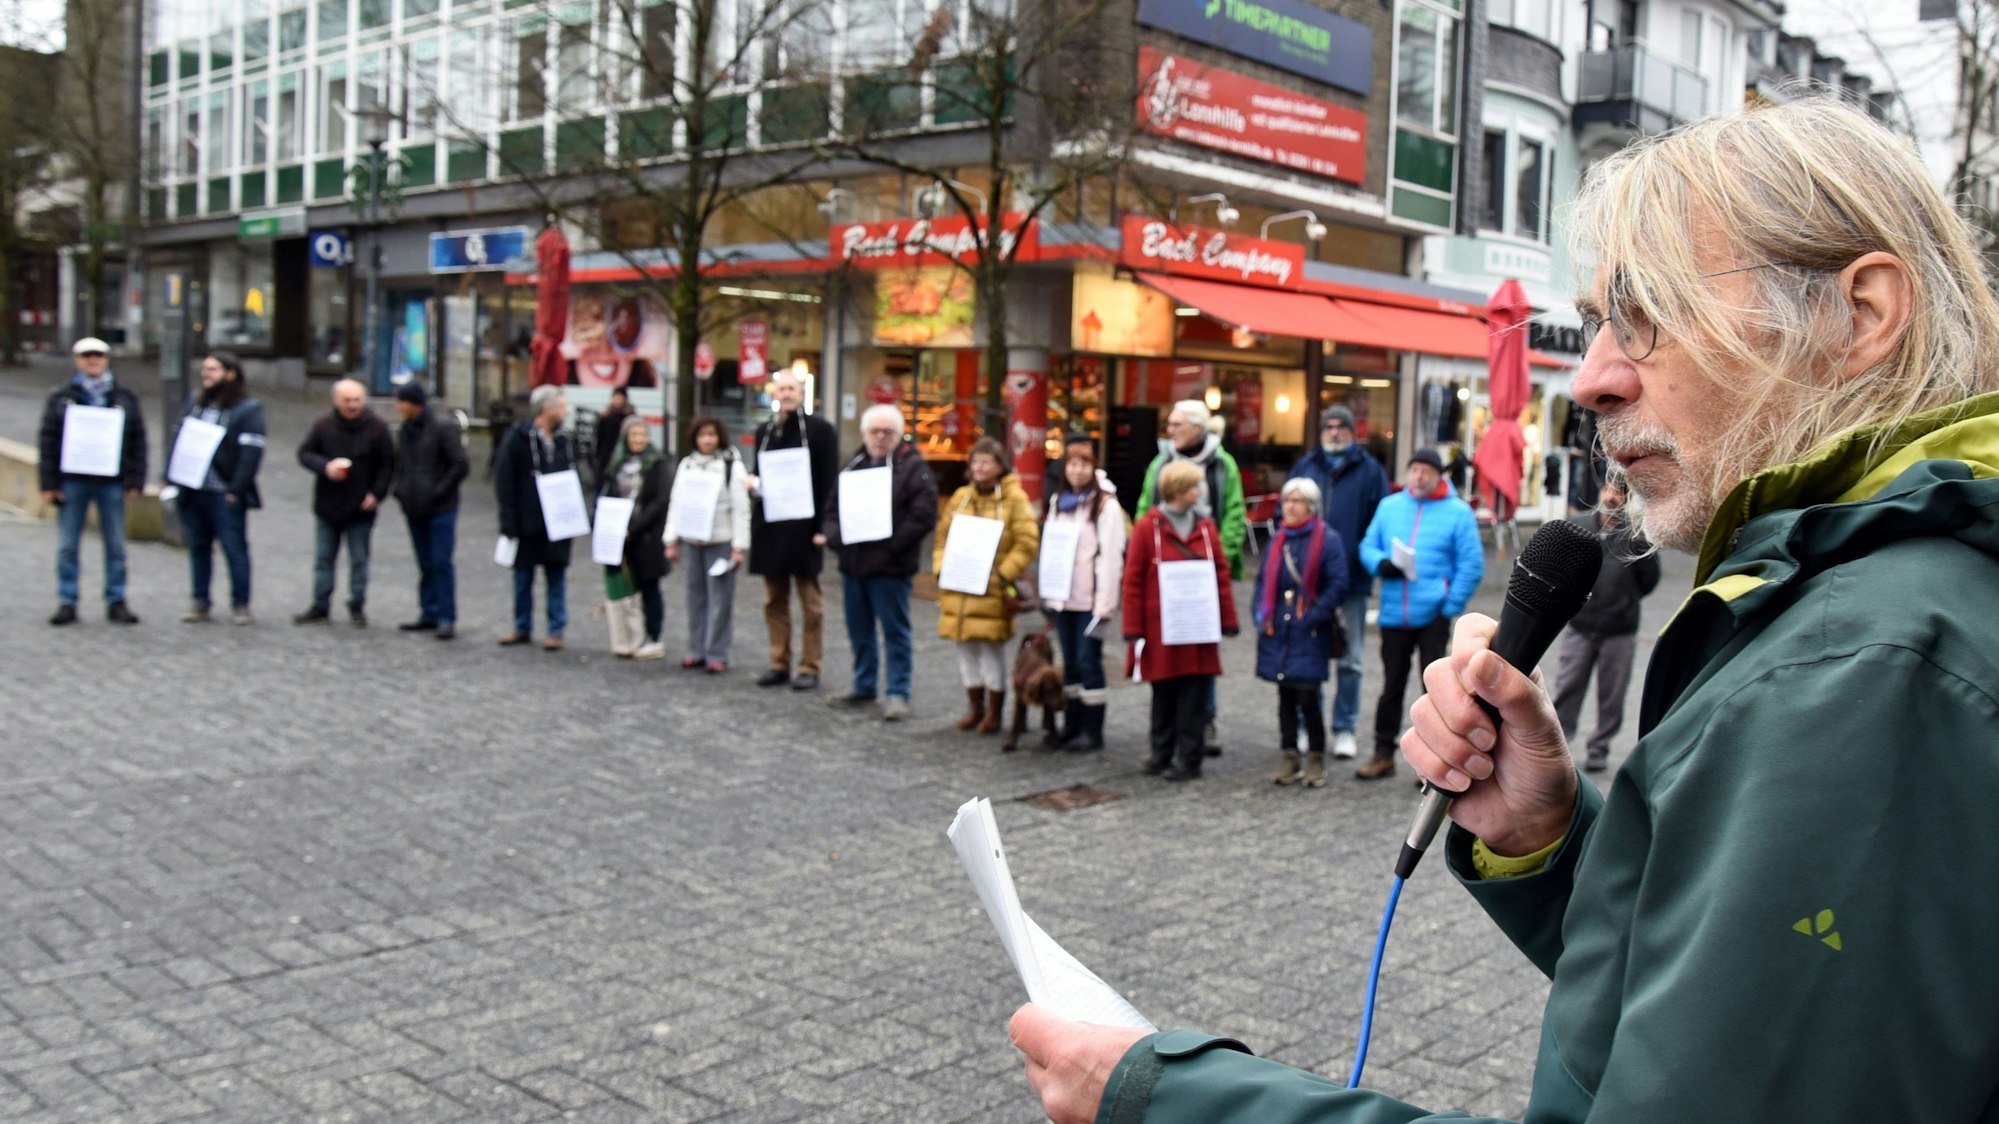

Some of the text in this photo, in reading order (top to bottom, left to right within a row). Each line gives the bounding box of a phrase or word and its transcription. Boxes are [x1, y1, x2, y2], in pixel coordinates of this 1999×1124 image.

[1225, 0, 1331, 51] TIMEPARTNER
[1142, 222, 1292, 286] Back Company
